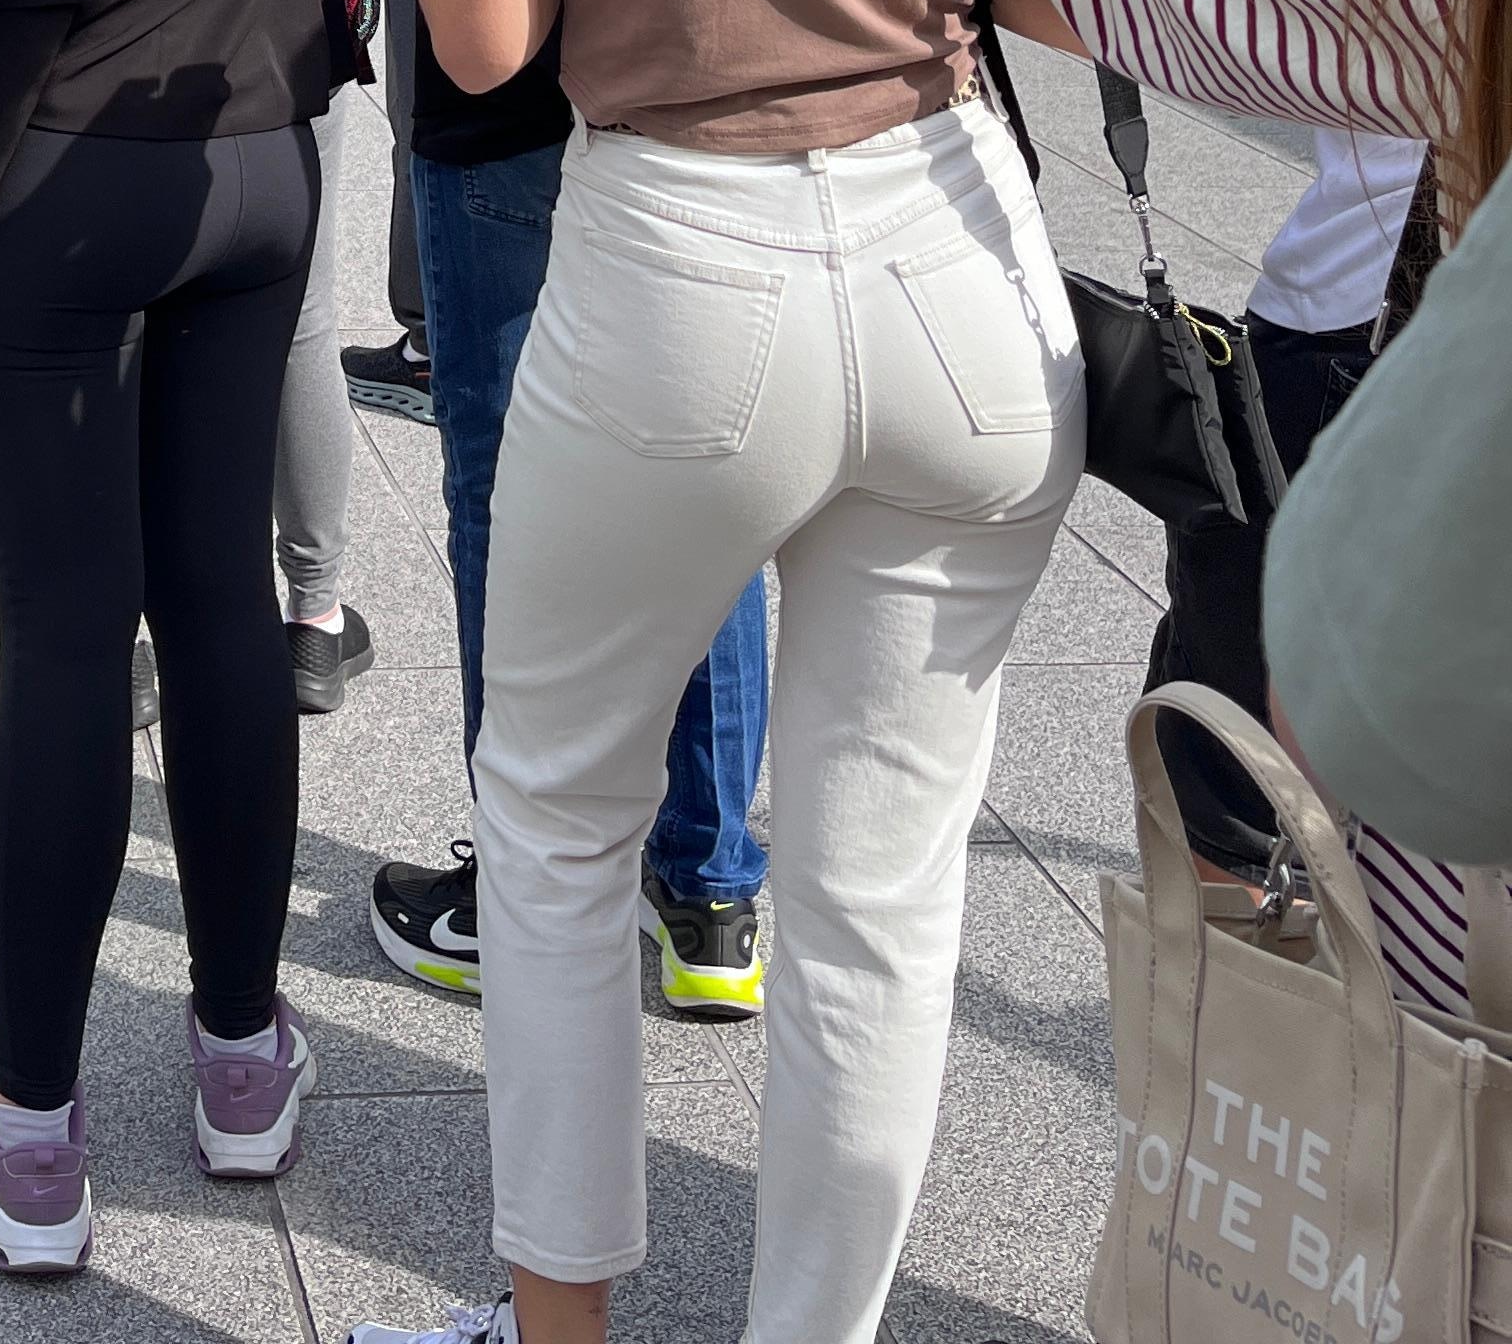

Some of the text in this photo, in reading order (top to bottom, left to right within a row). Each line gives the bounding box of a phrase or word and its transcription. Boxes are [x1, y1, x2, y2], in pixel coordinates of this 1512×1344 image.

[1205, 1077, 1332, 1202] THE
[1147, 1223, 1224, 1289] MARC
[1288, 1214, 1404, 1344] BAG
